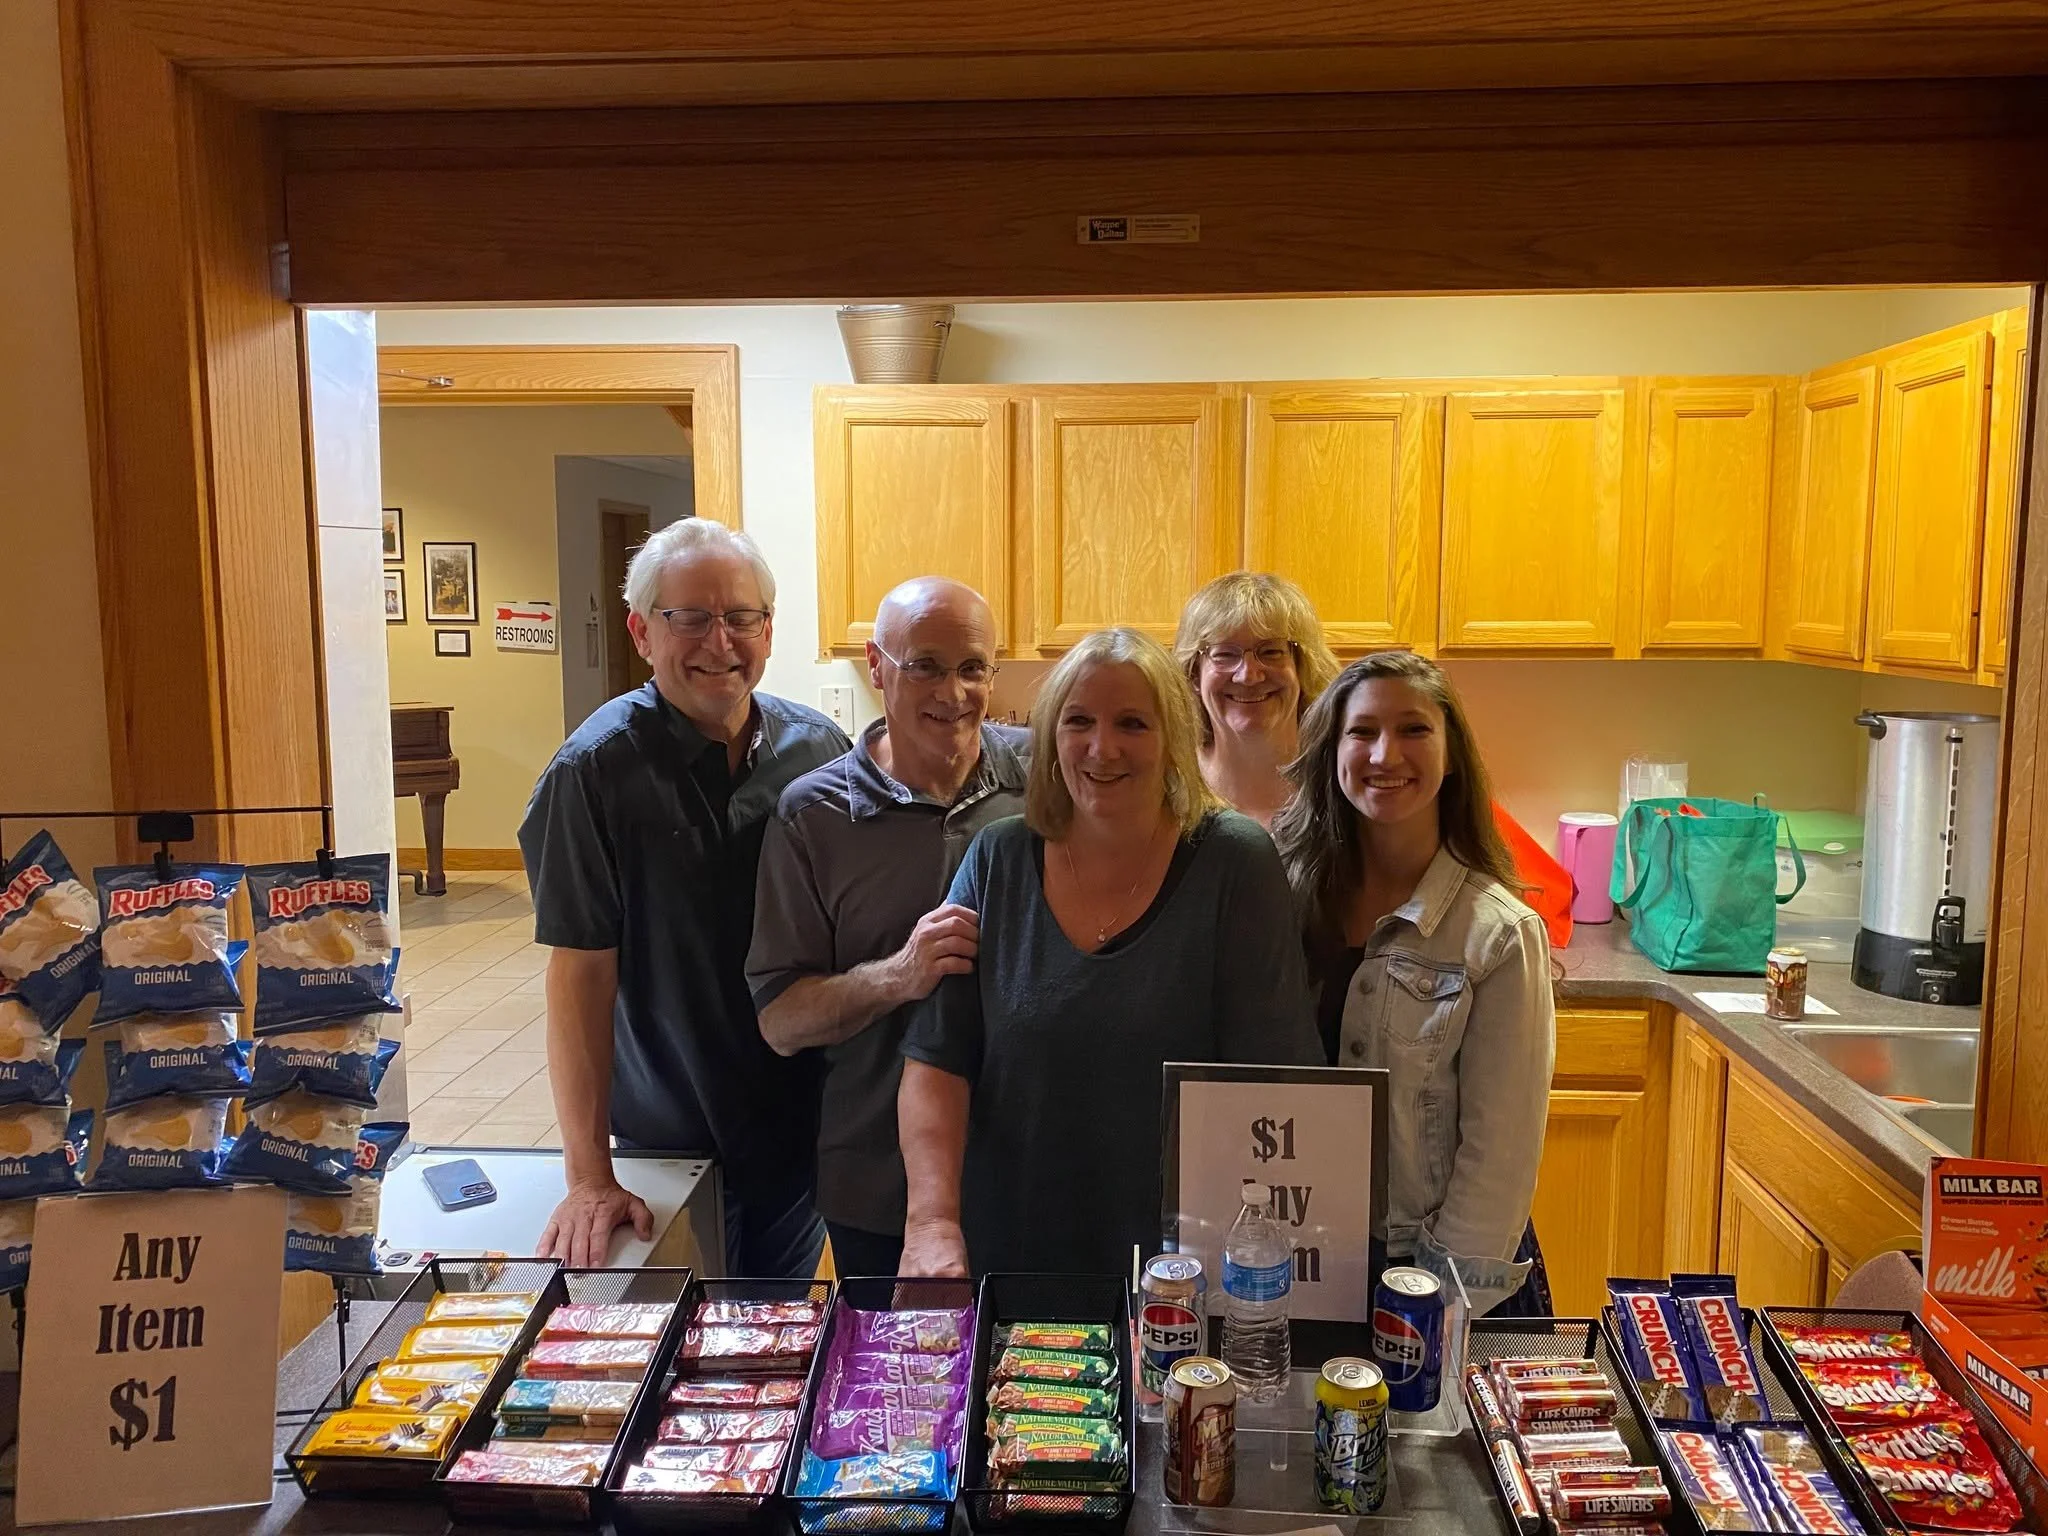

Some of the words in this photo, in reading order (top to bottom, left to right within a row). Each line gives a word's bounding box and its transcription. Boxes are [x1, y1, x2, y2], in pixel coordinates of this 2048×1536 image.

[495, 626, 554, 644] RESTROOMS
[108, 879, 215, 919] RUFFLES
[269, 880, 371, 918] RUFFLES
[50, 941, 100, 979] ORIGINAL
[134, 970, 192, 985] ORIGINAL
[300, 972, 354, 987] ORIGINAL
[150, 1053, 207, 1068] ORIGINAL
[286, 1054, 340, 1070] ORIGINAL
[1250, 1116, 1296, 1163] $1
[261, 1138, 309, 1163] ORIGINAL
[128, 1154, 183, 1168] ORIGINAL
[1942, 1177, 1993, 1194] MILK
[1996, 1179, 2038, 1194] BAR
[1940, 1215, 1967, 1224] Brown
[1968, 1217, 1994, 1226] Butter
[288, 1236, 336, 1254] ORIGINAL
[112, 1232, 202, 1284] Any
[1934, 1245, 2017, 1298] milk
[95, 1303, 205, 1354] Item
[1142, 1325, 1198, 1346] PEPSI
[1631, 1295, 1684, 1388] CRUNCH
[1699, 1299, 1756, 1396] CRUNCH
[1023, 1350, 1055, 1360] NATURE
[1055, 1352, 1084, 1363] VALLEY
[1034, 1359, 1072, 1367] CRUNCHY
[1028, 1384, 1060, 1393] NATURE
[1060, 1386, 1090, 1396] VALLEY
[1966, 1353, 1998, 1390] MILK
[2000, 1378, 2030, 1412] BAR
[1817, 1379, 1937, 1406] Skittles
[109, 1375, 177, 1451] $1
[1019, 1414, 1051, 1424] NATURE
[1054, 1416, 1085, 1427] VALLEY
[1538, 1408, 1561, 1419] LIFE
[1562, 1406, 1601, 1417] SAVERS
[1031, 1423, 1071, 1431] CRUNCHY
[1531, 1420, 1569, 1433] SAVERS
[1031, 1433, 1063, 1442] NATURE
[1066, 1434, 1096, 1443] VALLEY
[1020, 1479, 1056, 1489] NATURE
[1056, 1480, 1088, 1490] VALLEY
[1865, 1465, 1995, 1499] Skittles
[1584, 1498, 1609, 1513] LIFE
[1609, 1496, 1654, 1513] SAVERS
